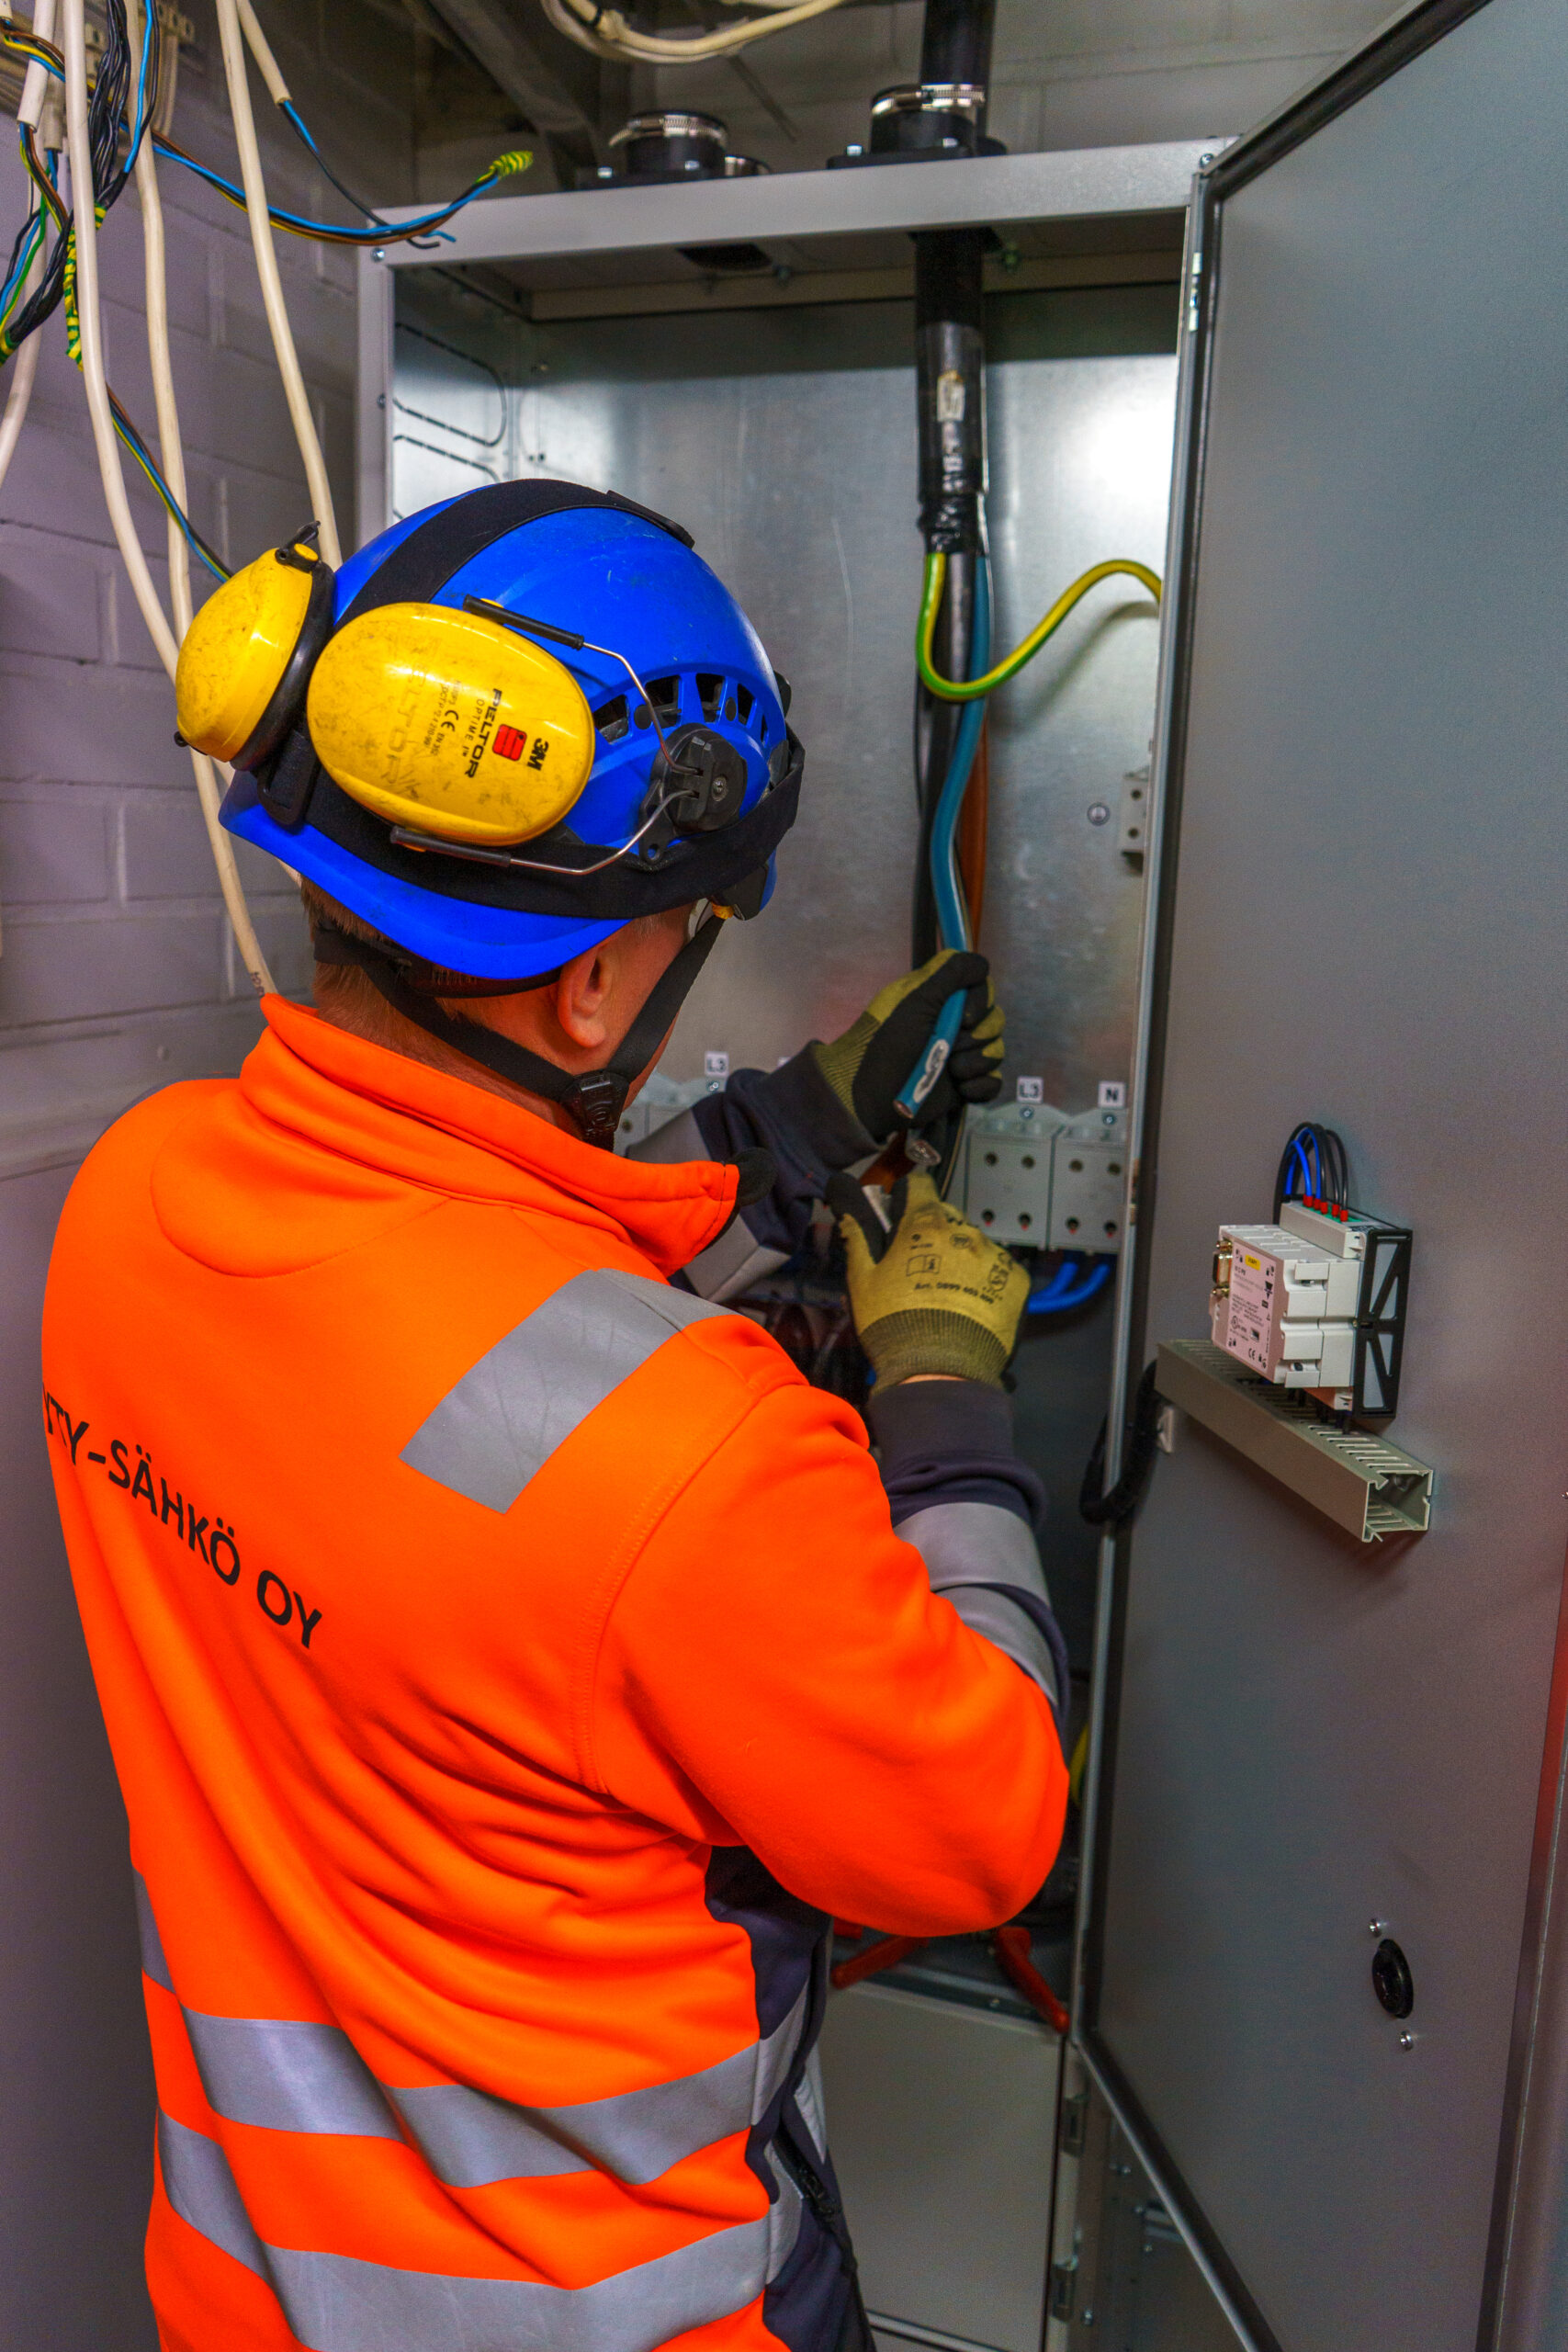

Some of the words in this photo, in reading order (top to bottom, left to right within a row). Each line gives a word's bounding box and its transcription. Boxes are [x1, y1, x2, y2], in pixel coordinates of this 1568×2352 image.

[465, 699, 485, 741] OPTIME
[465, 688, 502, 778] PELTOR
[527, 738, 548, 771] 3M
[707, 1058, 726, 1073] L3
[1106, 1089, 1118, 1101] N
[256, 1569, 322, 1649] OY
